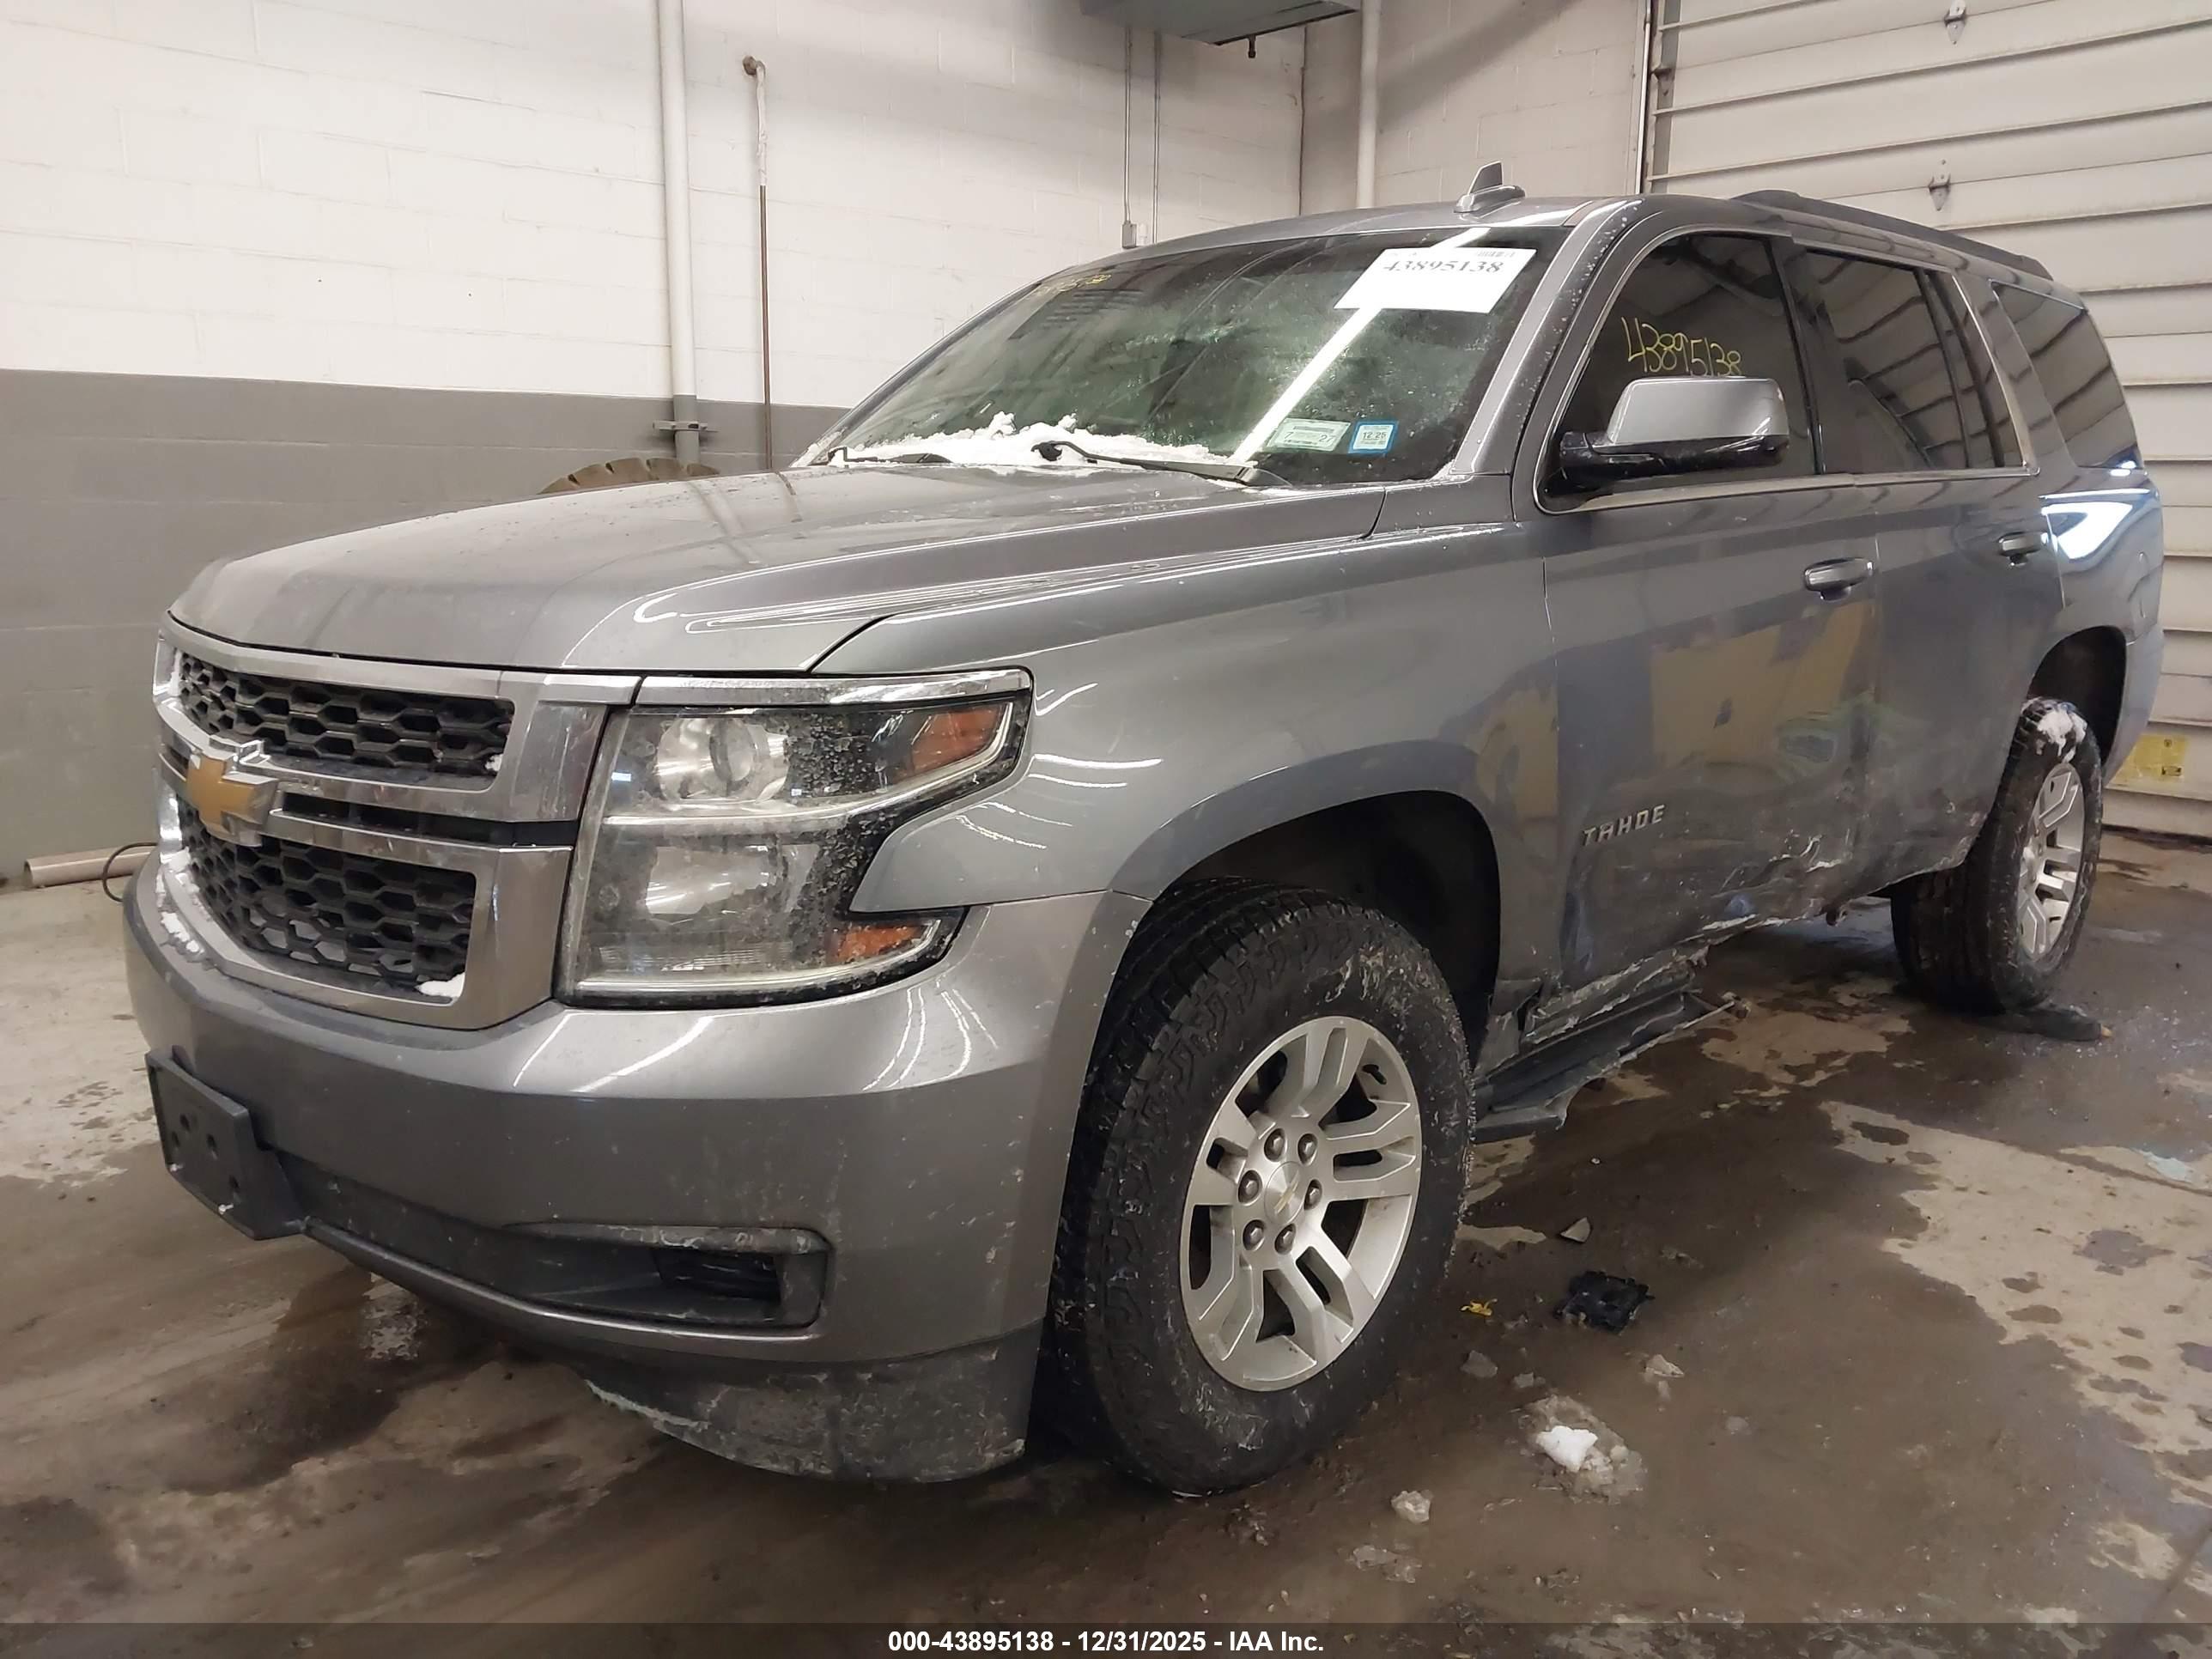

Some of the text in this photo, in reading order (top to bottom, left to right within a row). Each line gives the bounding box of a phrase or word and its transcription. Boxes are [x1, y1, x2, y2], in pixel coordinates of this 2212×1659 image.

[1382, 260, 1504, 273] 43895138
[1620, 316, 1742, 377] 43895138
[1582, 805, 1665, 847] TAHOE
